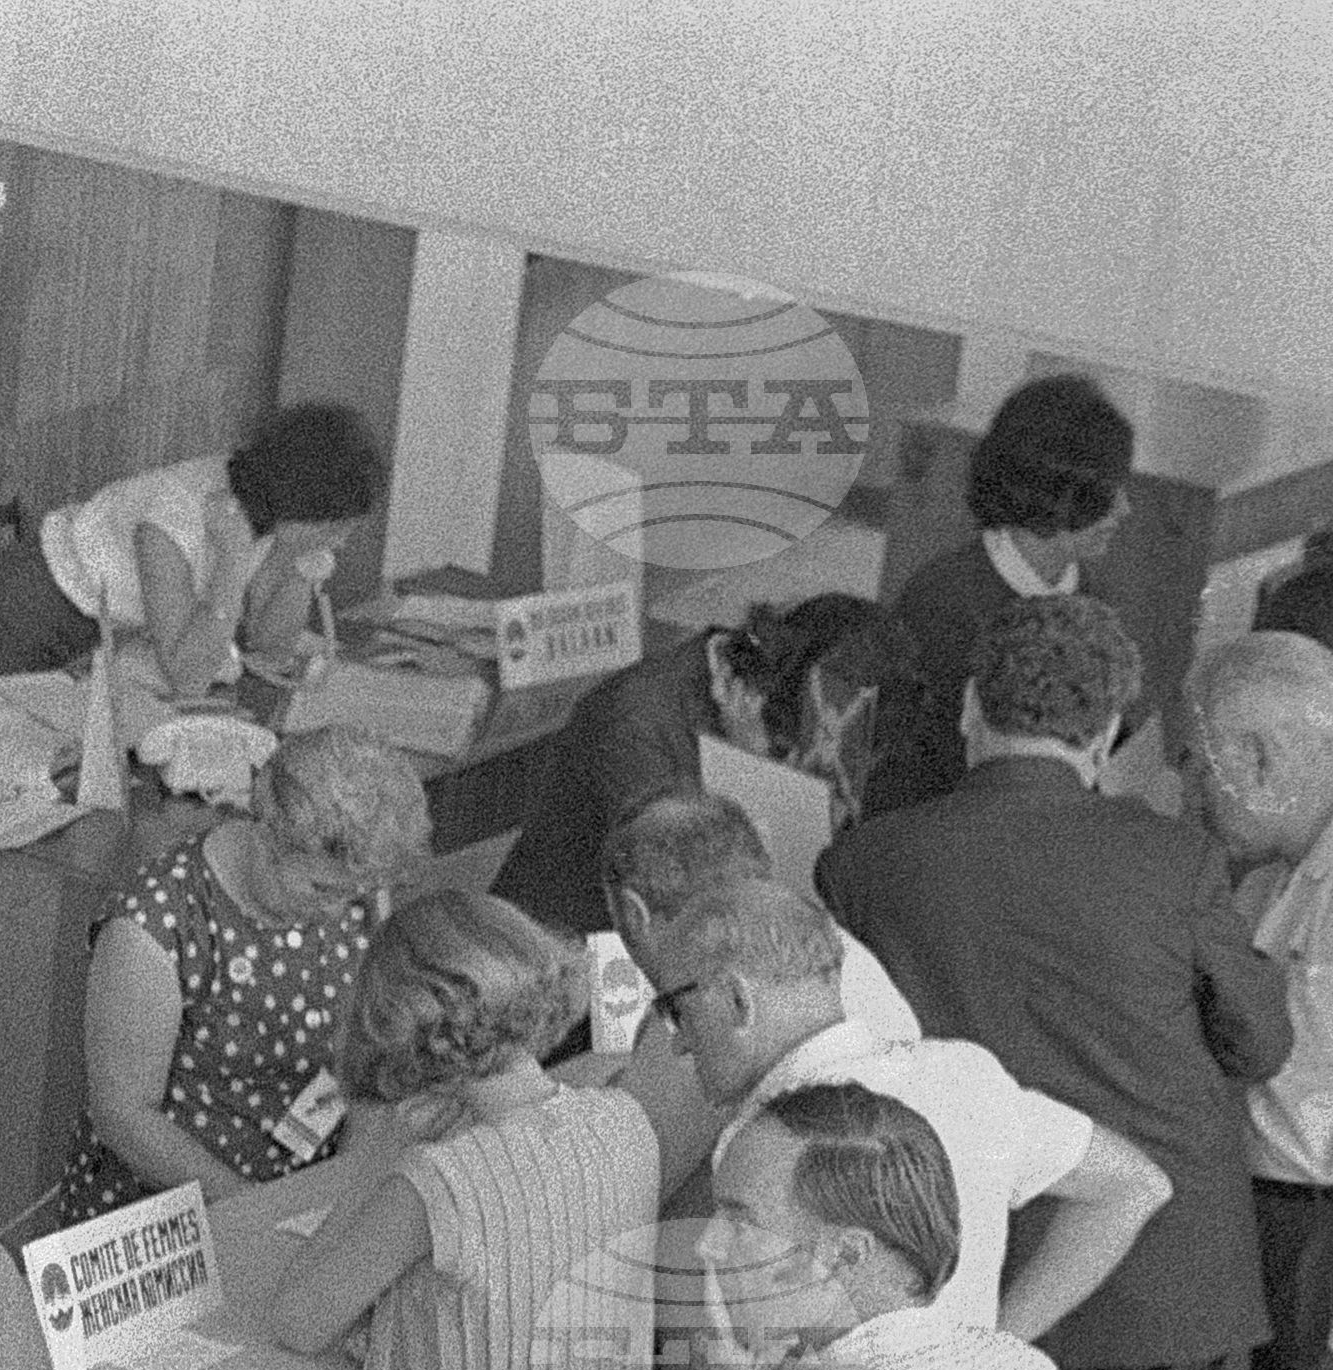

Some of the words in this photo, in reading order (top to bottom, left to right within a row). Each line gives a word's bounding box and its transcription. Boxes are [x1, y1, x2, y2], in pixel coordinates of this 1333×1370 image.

[70, 1240, 123, 1292] COMITE
[122, 1229, 143, 1270] DE
[141, 1208, 201, 1262] FEMMES
[138, 1249, 209, 1309] КОМИССИЯ
